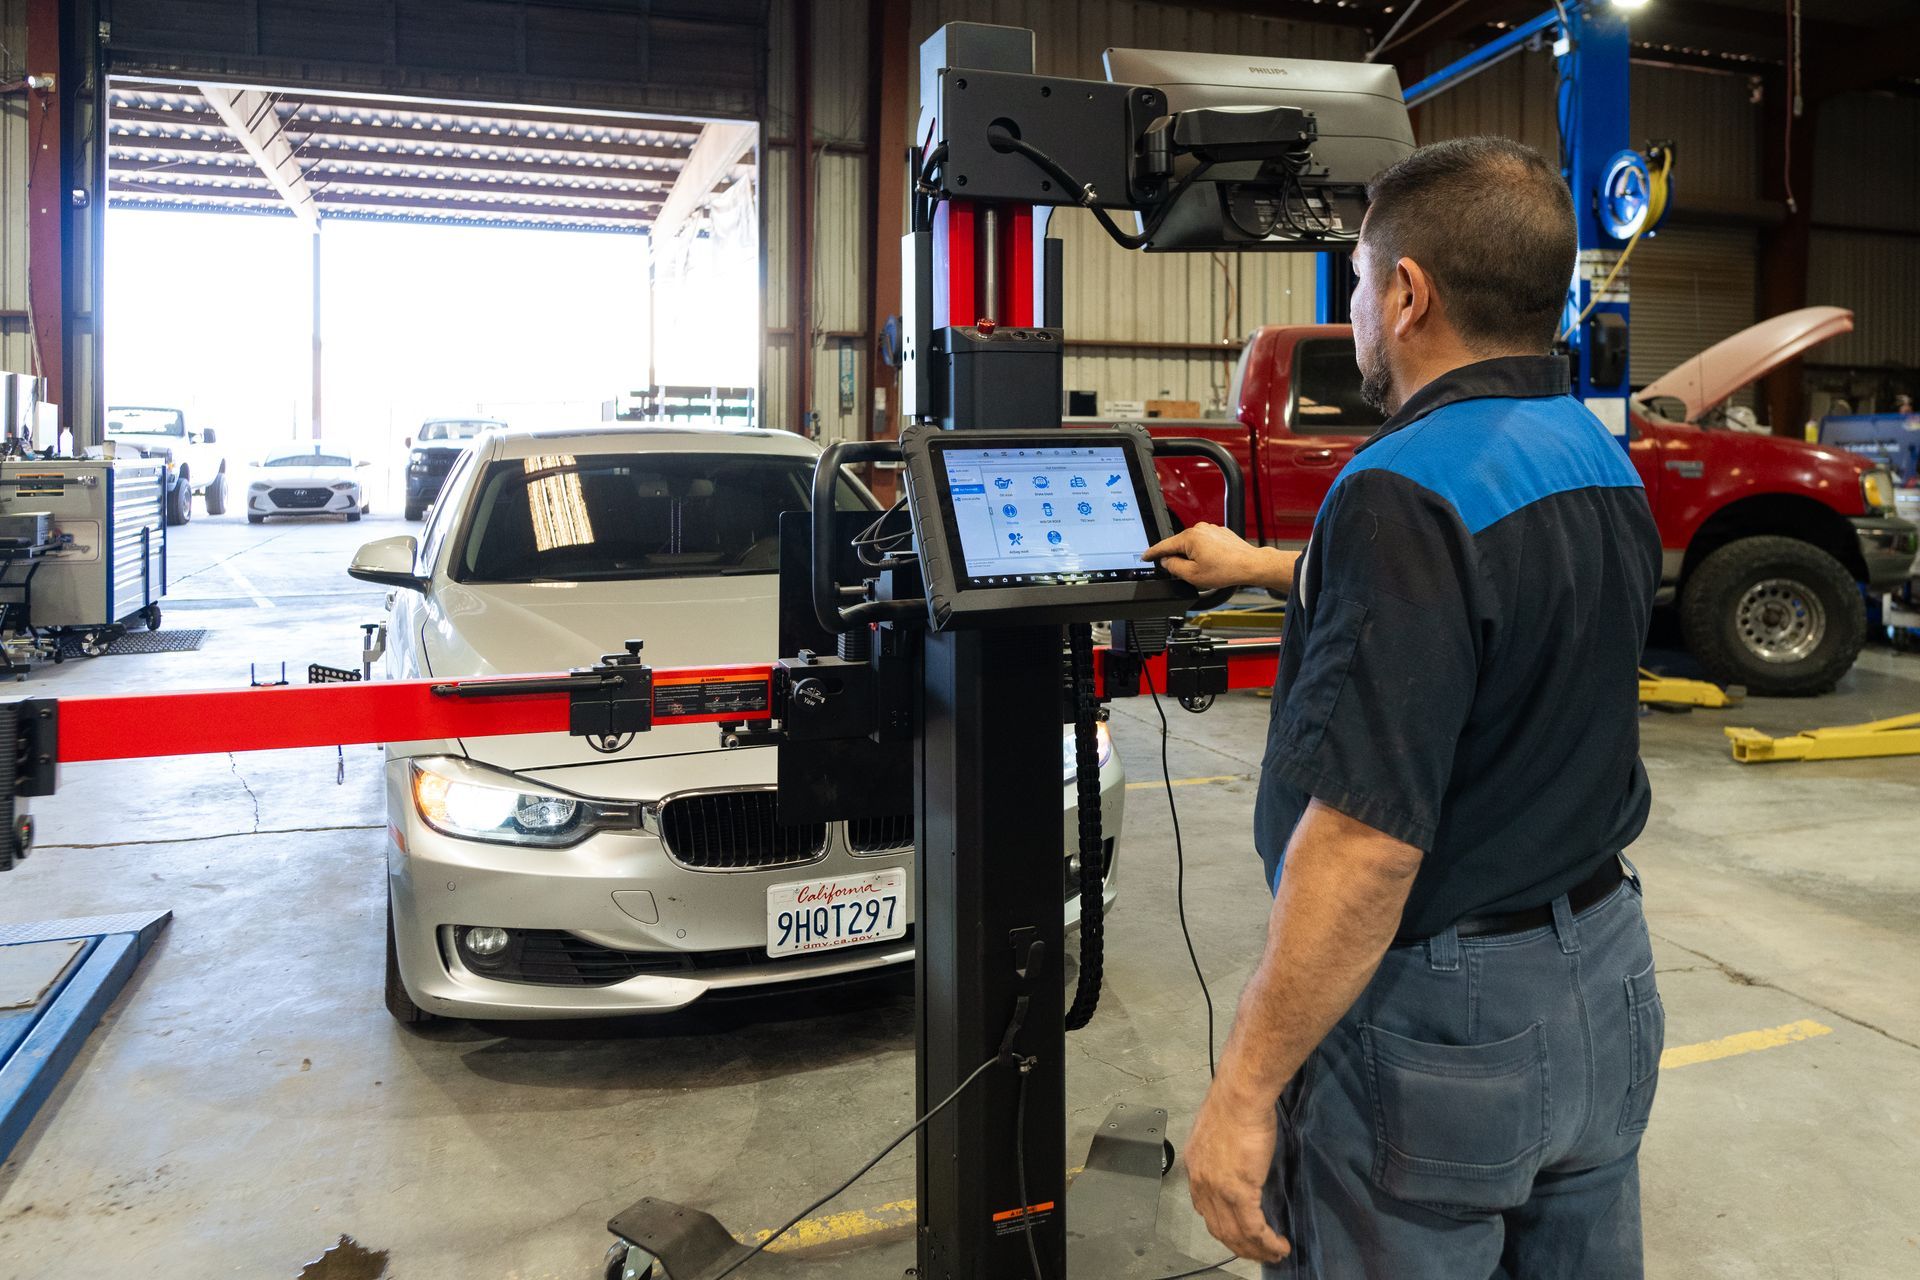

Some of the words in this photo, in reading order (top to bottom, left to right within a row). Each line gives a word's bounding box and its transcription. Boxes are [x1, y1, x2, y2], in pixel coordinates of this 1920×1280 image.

[1248, 67, 1288, 75] PHILIPS
[797, 882, 881, 904] California
[777, 896, 897, 946] 9HQT297
[803, 934, 873, 950] dmv.ca.gov
